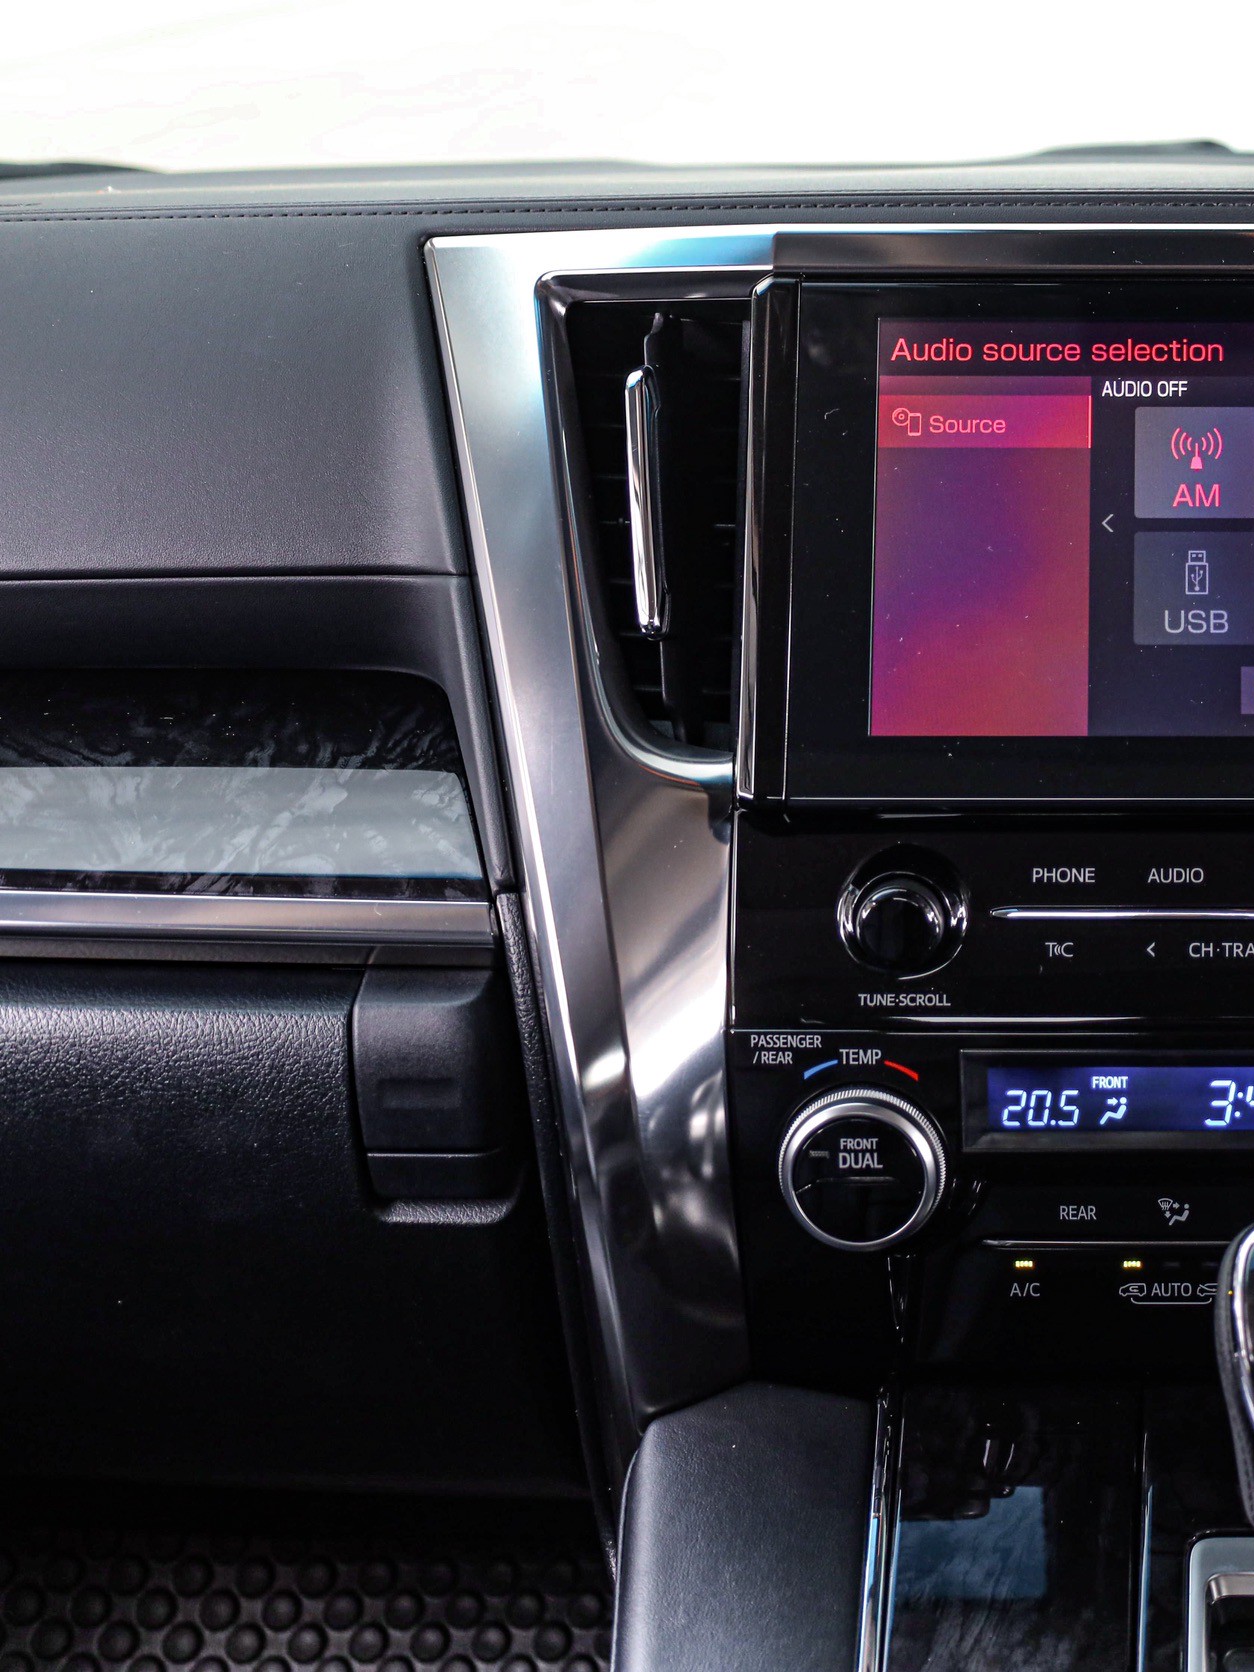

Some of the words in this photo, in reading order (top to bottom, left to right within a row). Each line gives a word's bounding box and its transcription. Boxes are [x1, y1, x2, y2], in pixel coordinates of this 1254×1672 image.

[891, 338, 973, 362] Audio
[982, 343, 1081, 362] source
[1091, 338, 1225, 362] selection
[1102, 380, 1153, 397] AUDIO
[1157, 380, 1188, 397] OFF
[929, 415, 1006, 434] Source
[1172, 484, 1222, 507] AM
[1163, 610, 1229, 635] USB
[1032, 868, 1096, 884] PHONE
[1148, 868, 1204, 884] AUDIO
[750, 1034, 822, 1049] PASSENGER
[839, 1048, 882, 1065] TEMP
[1092, 1076, 1128, 1090] FRONT
[1002, 1090, 1080, 1126] 20.5
[840, 1138, 878, 1150] FRONT
[838, 1152, 883, 1169] DUAL
[1059, 1205, 1097, 1221] REAR
[1010, 1282, 1041, 1297] A/C
[1151, 1282, 1193, 1297] AUTO
